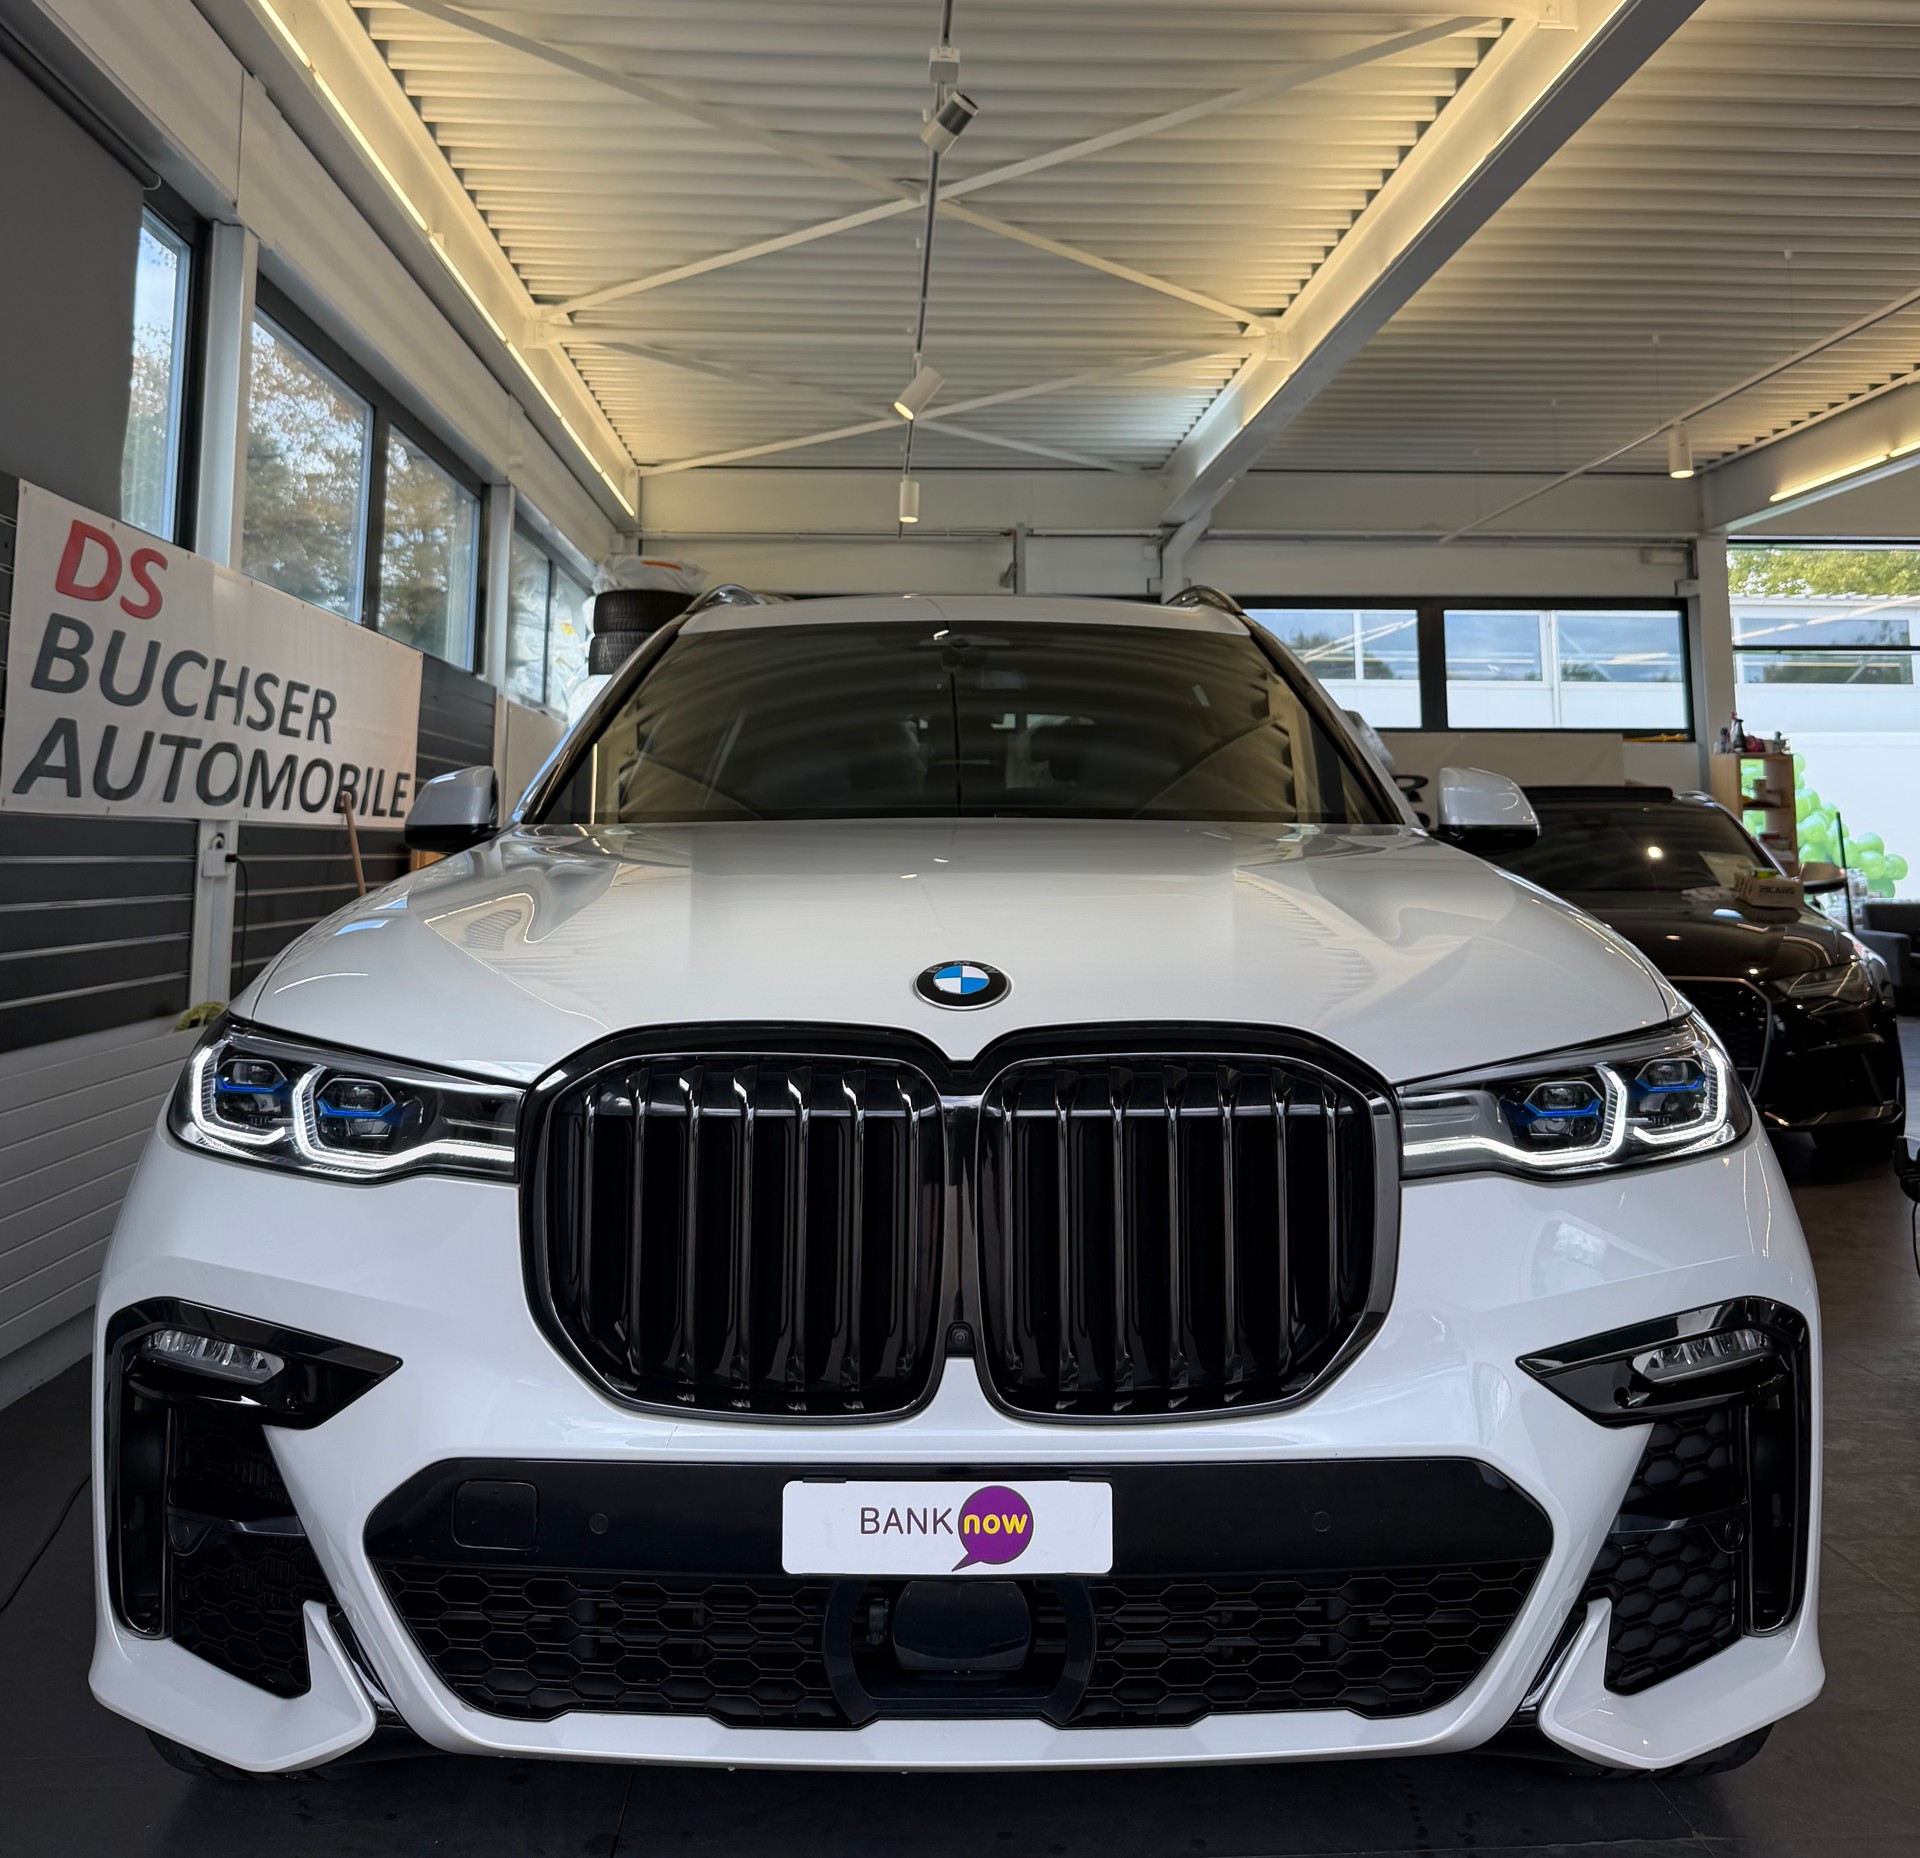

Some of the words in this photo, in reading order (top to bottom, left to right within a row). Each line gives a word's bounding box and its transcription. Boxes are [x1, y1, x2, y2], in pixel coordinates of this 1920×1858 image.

[55, 519, 168, 619] DS
[31, 612, 337, 744] BUCHSER
[13, 717, 412, 818] AUTOMOBILE
[860, 1507, 953, 1535] BANK
[963, 1514, 1028, 1534] now
